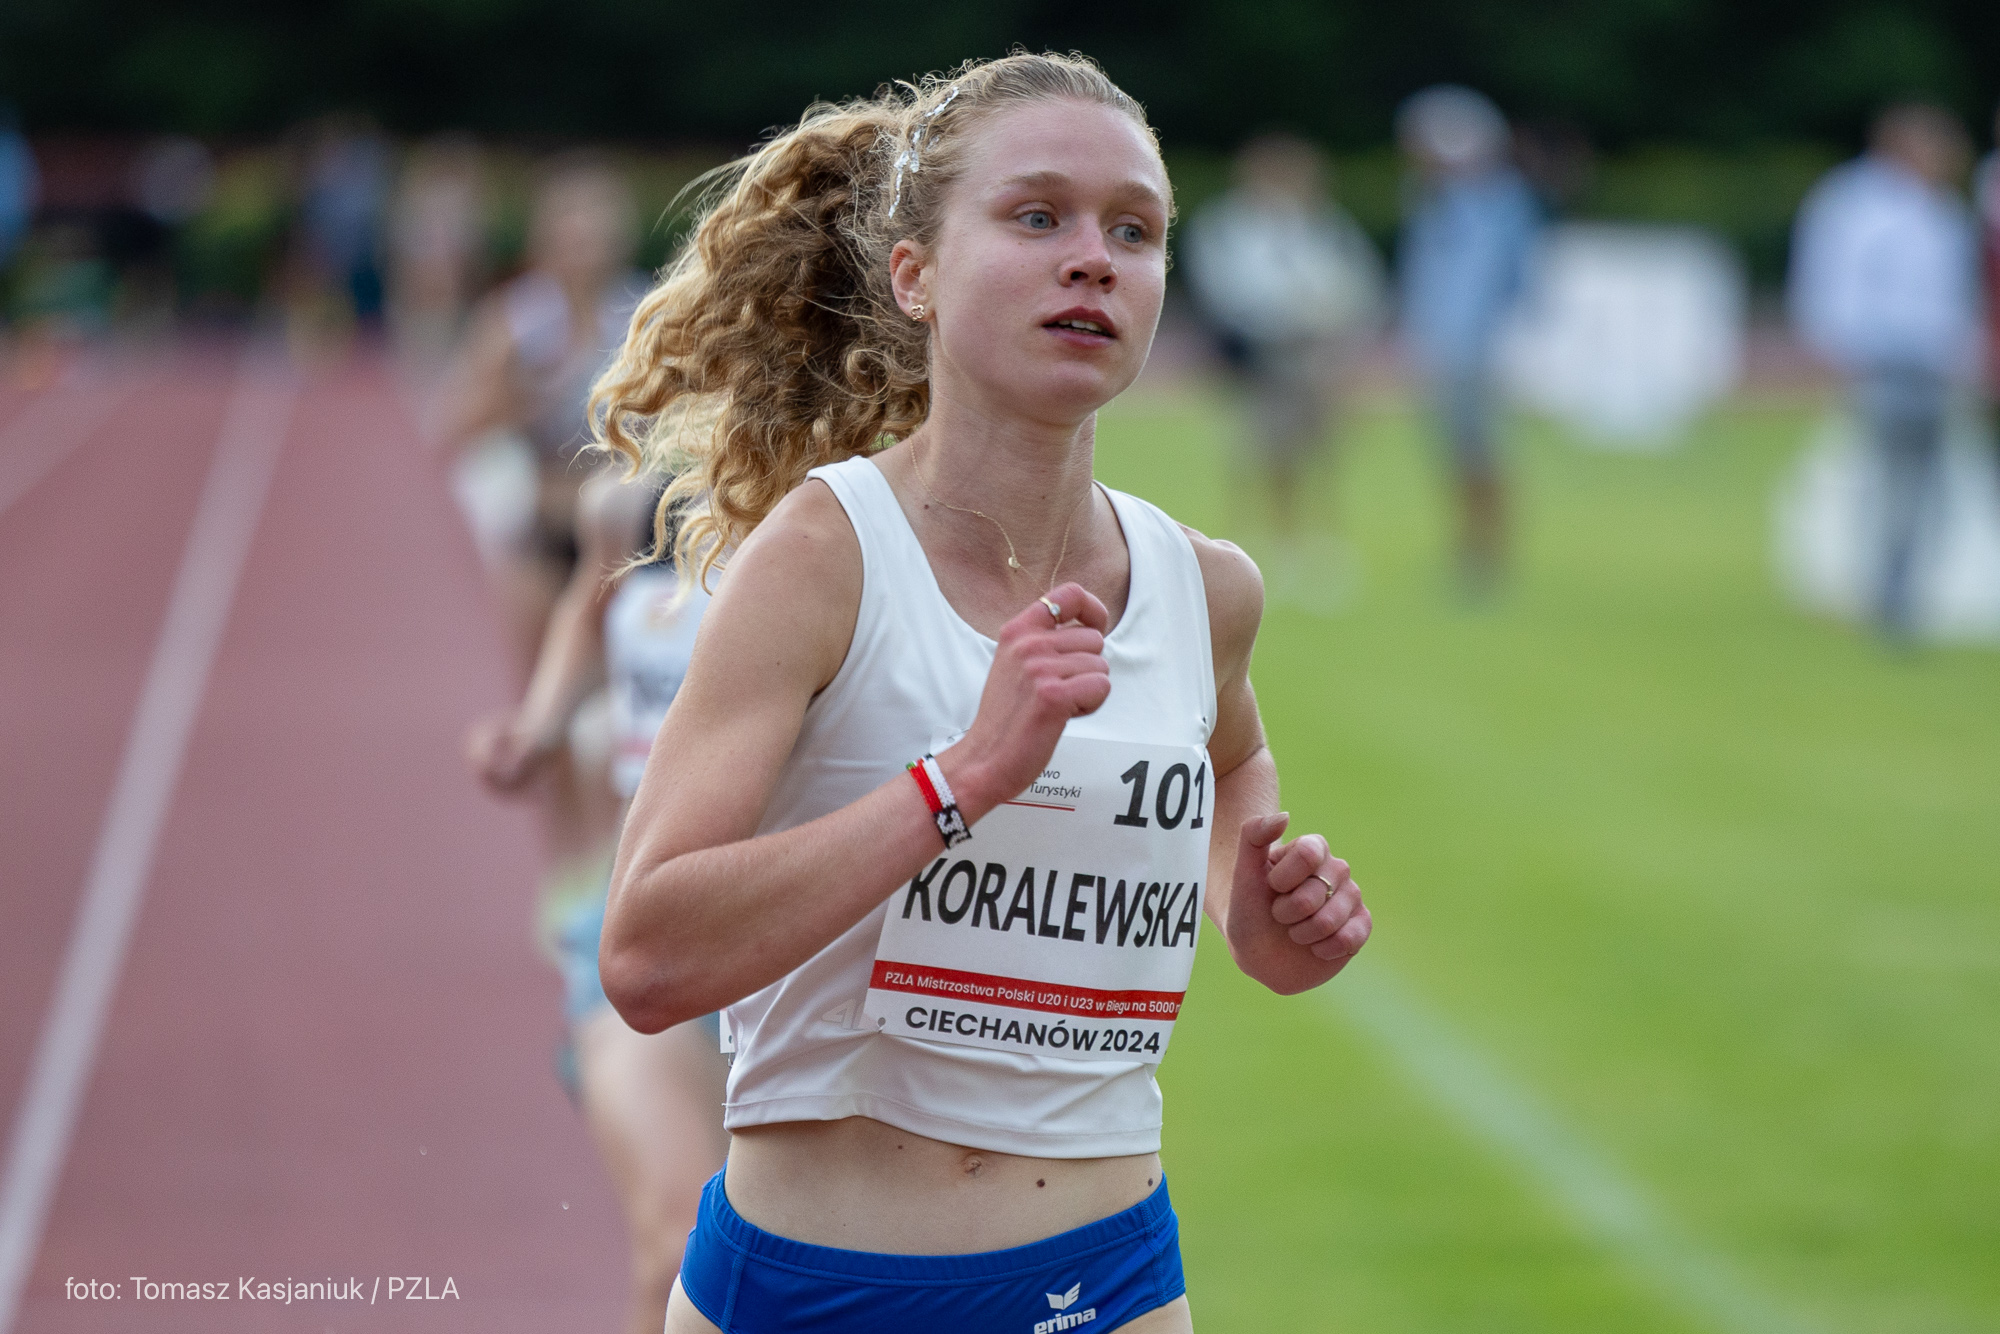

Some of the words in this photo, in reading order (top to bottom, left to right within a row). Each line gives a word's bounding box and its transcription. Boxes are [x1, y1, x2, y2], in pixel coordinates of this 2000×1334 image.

[1029, 781, 1082, 799] Turystyki
[1113, 760, 1206, 831] 101
[901, 857, 1199, 948] KORALEWSKA
[884, 971, 914, 986] PZLA
[916, 975, 995, 997] Mistrzostwa
[997, 986, 1035, 1003] Polski
[1037, 992, 1062, 1006] U20
[1063, 995, 1068, 1007] i
[1069, 997, 1093, 1010] U23
[1095, 1001, 1105, 1011] w
[1105, 1000, 1130, 1015] Biegu
[1131, 1003, 1146, 1012] na
[905, 1006, 1099, 1052] CIECHANÓW
[1099, 1028, 1160, 1055] 2024
[1033, 1307, 1097, 1334] erima
